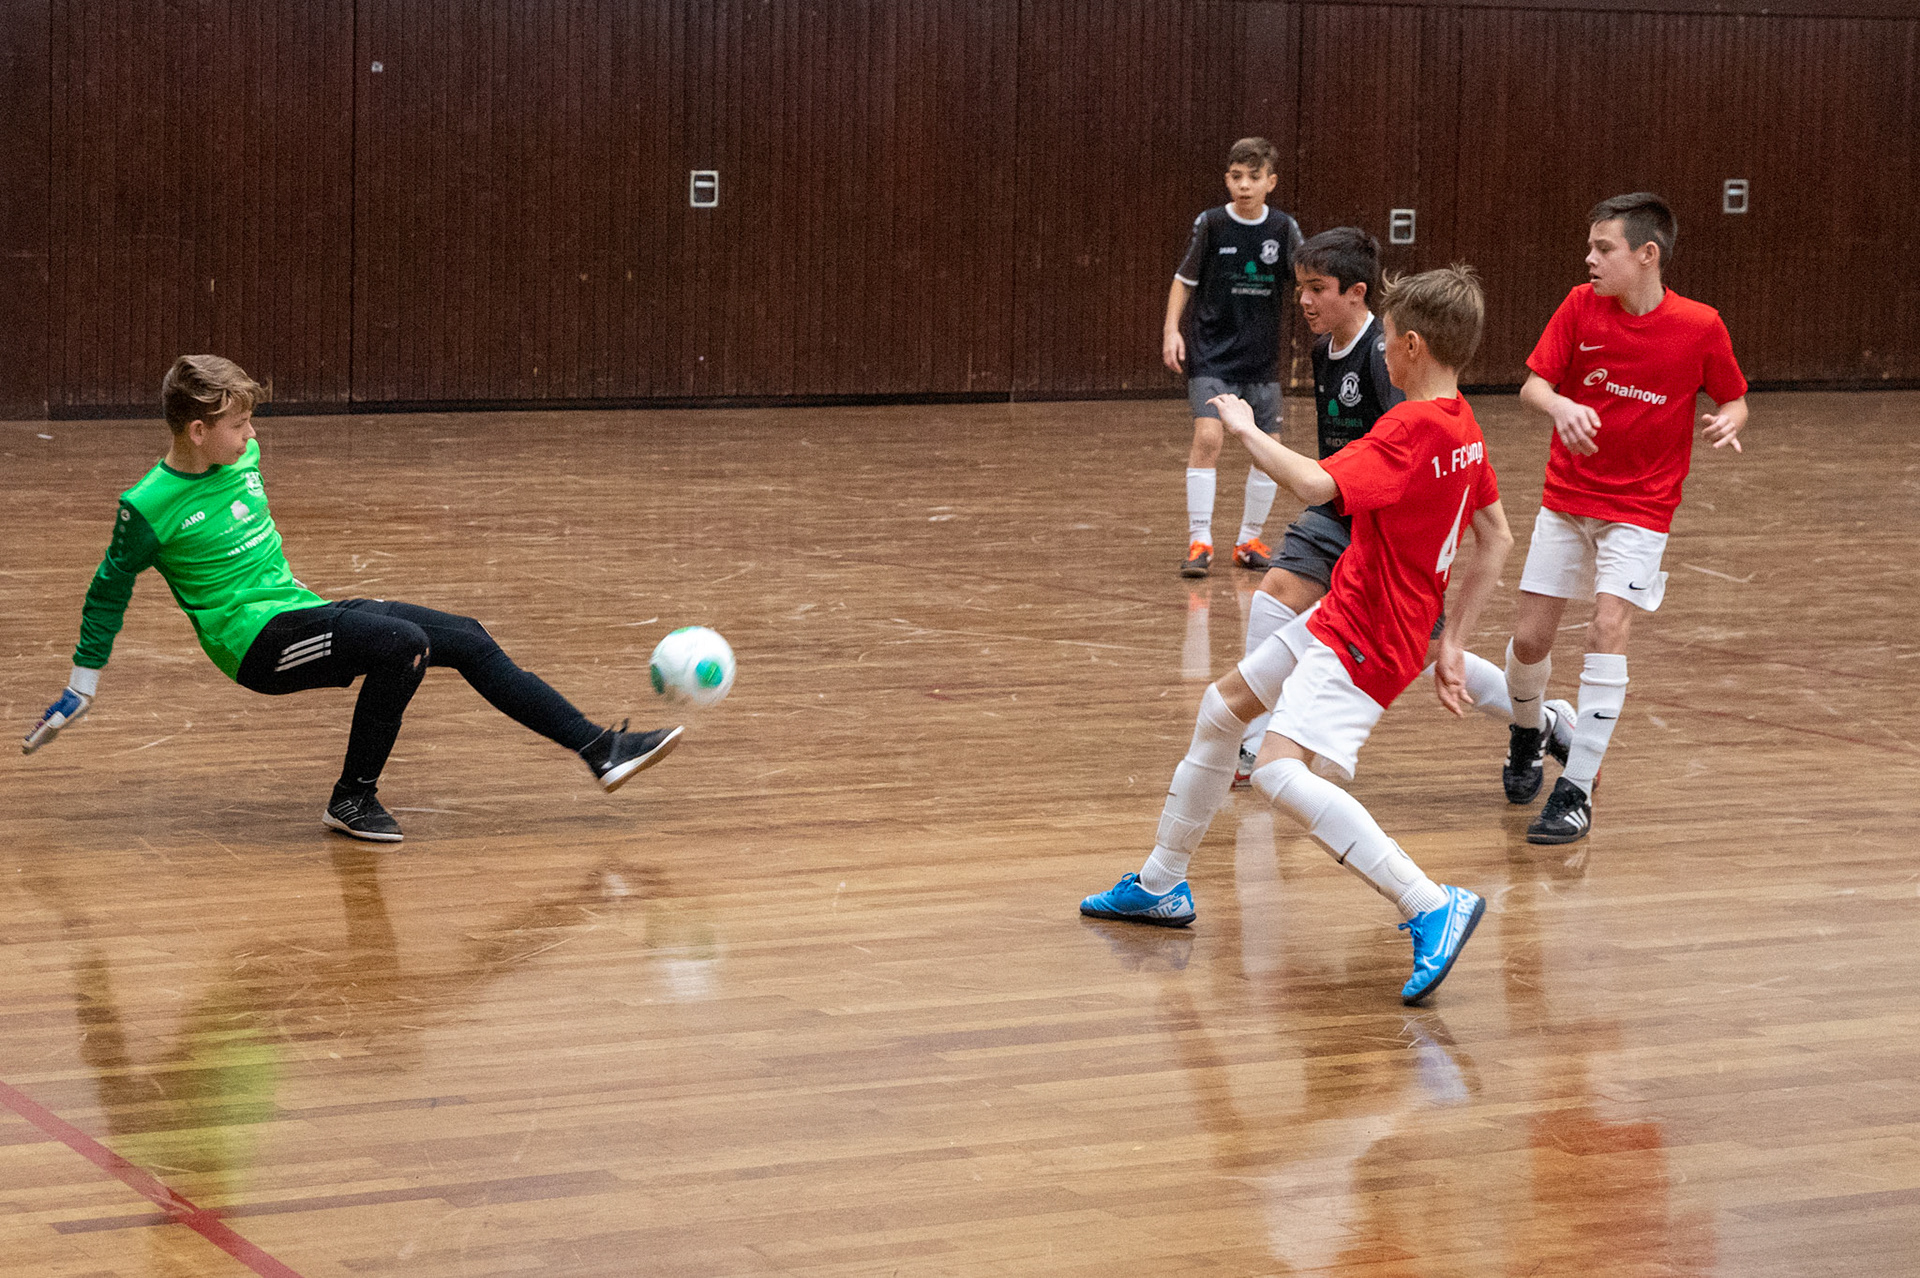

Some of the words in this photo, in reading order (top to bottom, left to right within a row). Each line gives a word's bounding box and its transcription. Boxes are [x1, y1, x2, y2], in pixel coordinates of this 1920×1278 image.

[1605, 381, 1667, 405] mainova
[1431, 456, 1447, 479] 1.
[1451, 447, 1467, 473] FC
[182, 511, 206, 530] JAKO
[1435, 484, 1470, 582] 4
